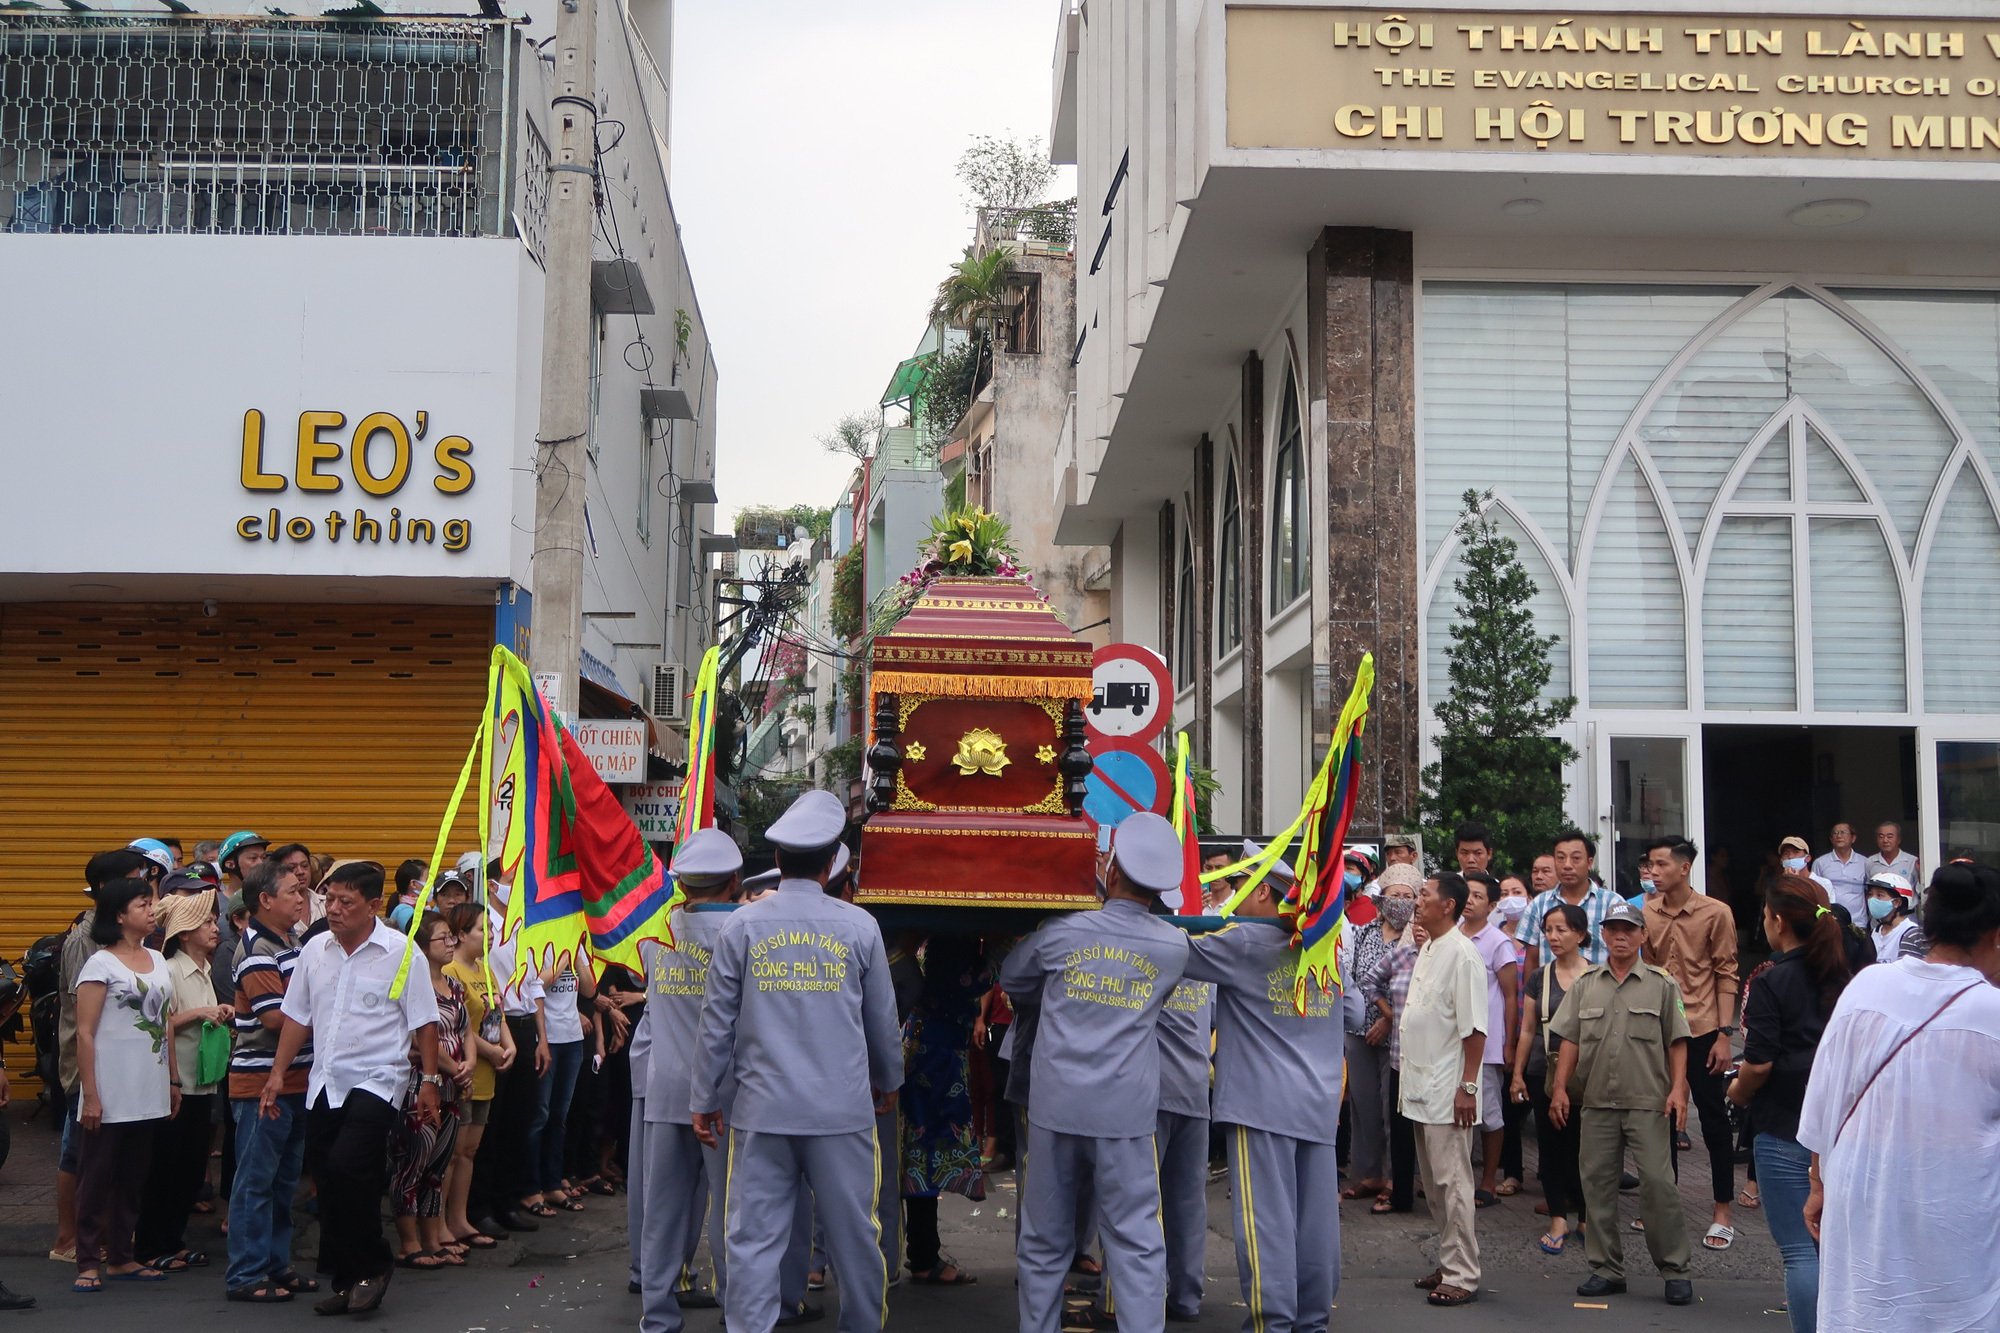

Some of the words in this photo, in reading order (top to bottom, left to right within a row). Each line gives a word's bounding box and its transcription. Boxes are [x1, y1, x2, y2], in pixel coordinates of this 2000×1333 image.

[1334, 14, 1434, 54] HỘI
[1458, 18, 1664, 53] THÁNH
[1685, 28, 1783, 54] TIN
[1807, 21, 1965, 57] LÀNH
[1374, 67, 1456, 87] THE
[1474, 70, 1760, 93] EVANGELICAL
[1776, 75, 1950, 95] CHURCH
[1334, 104, 1444, 138] CHI
[1474, 100, 1585, 149] HỘI
[1608, 105, 1869, 147] TRƯƠNG
[240, 408, 476, 497] LEO's
[237, 507, 472, 553] clothing
[579, 725, 598, 749] ỘT
[601, 726, 642, 746] CHIÊN
[607, 751, 637, 775] MẬP
[634, 803, 660, 816] NUI
[663, 801, 680, 816] XÀ
[638, 816, 655, 832] MÌ
[657, 816, 676, 832] XÀ
[750, 940, 768, 959] CƠ
[768, 928, 787, 949] SỞ
[790, 931, 816, 945] MAI
[819, 933, 849, 960] TÁNG
[752, 956, 788, 978] CÔNG
[793, 956, 817, 977] PHỦ
[822, 962, 847, 982] THỌ
[1083, 942, 1100, 960] SỞ
[1104, 946, 1130, 963] MAI
[1131, 955, 1160, 981] TÁNG
[758, 980, 840, 993] ĐT:0903.885.061
[1063, 966, 1096, 989] CÔNG
[1101, 973, 1127, 994] PHỦ
[1131, 980, 1154, 1002] THỌ
[1066, 987, 1144, 1011] ĐT:0903.885.061
